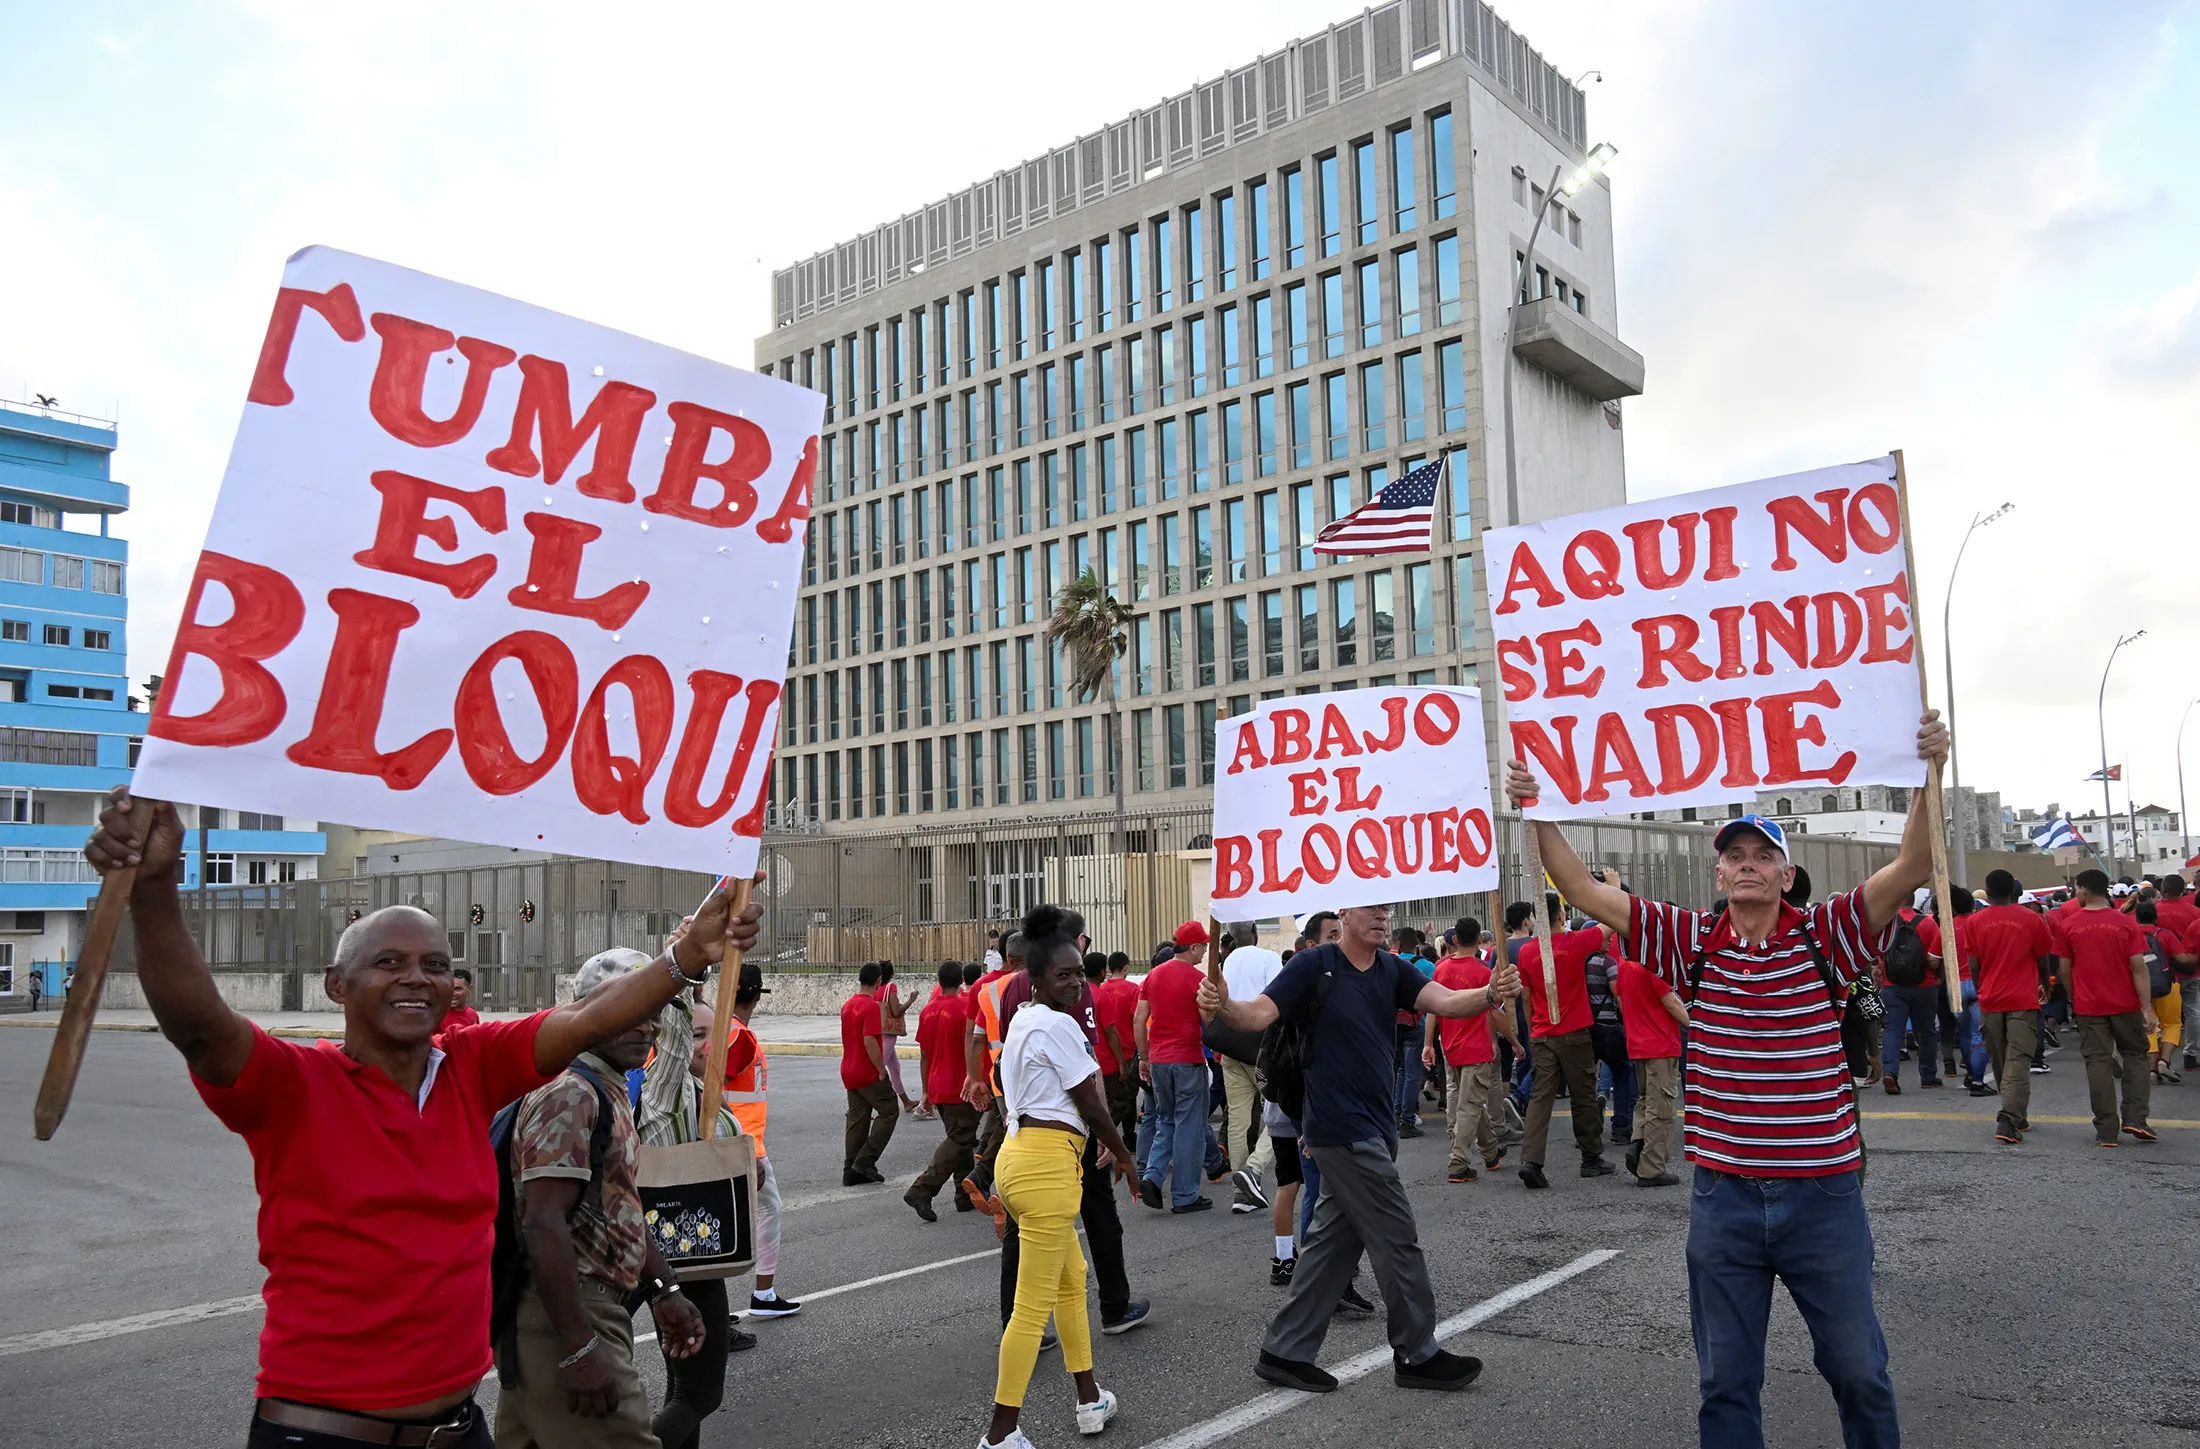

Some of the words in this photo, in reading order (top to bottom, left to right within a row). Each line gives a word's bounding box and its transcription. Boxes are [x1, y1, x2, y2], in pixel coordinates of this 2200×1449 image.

[248, 282, 819, 544] TUMBA
[353, 469, 651, 631] EL
[1495, 506, 1741, 615] AQUI
[1766, 482, 1901, 571] NO
[148, 550, 785, 838] BLOQU
[1497, 618, 1606, 702] SE
[1631, 571, 1914, 690] RINDE
[1227, 692, 1461, 775] ABAJO
[1288, 766, 1383, 817] EL
[1510, 679, 1857, 806] NADIE
[1077, 811, 1118, 819] AMERIC
[1210, 806, 1493, 900] BLOQUEO
[655, 1200, 682, 1209] SOLARIS
